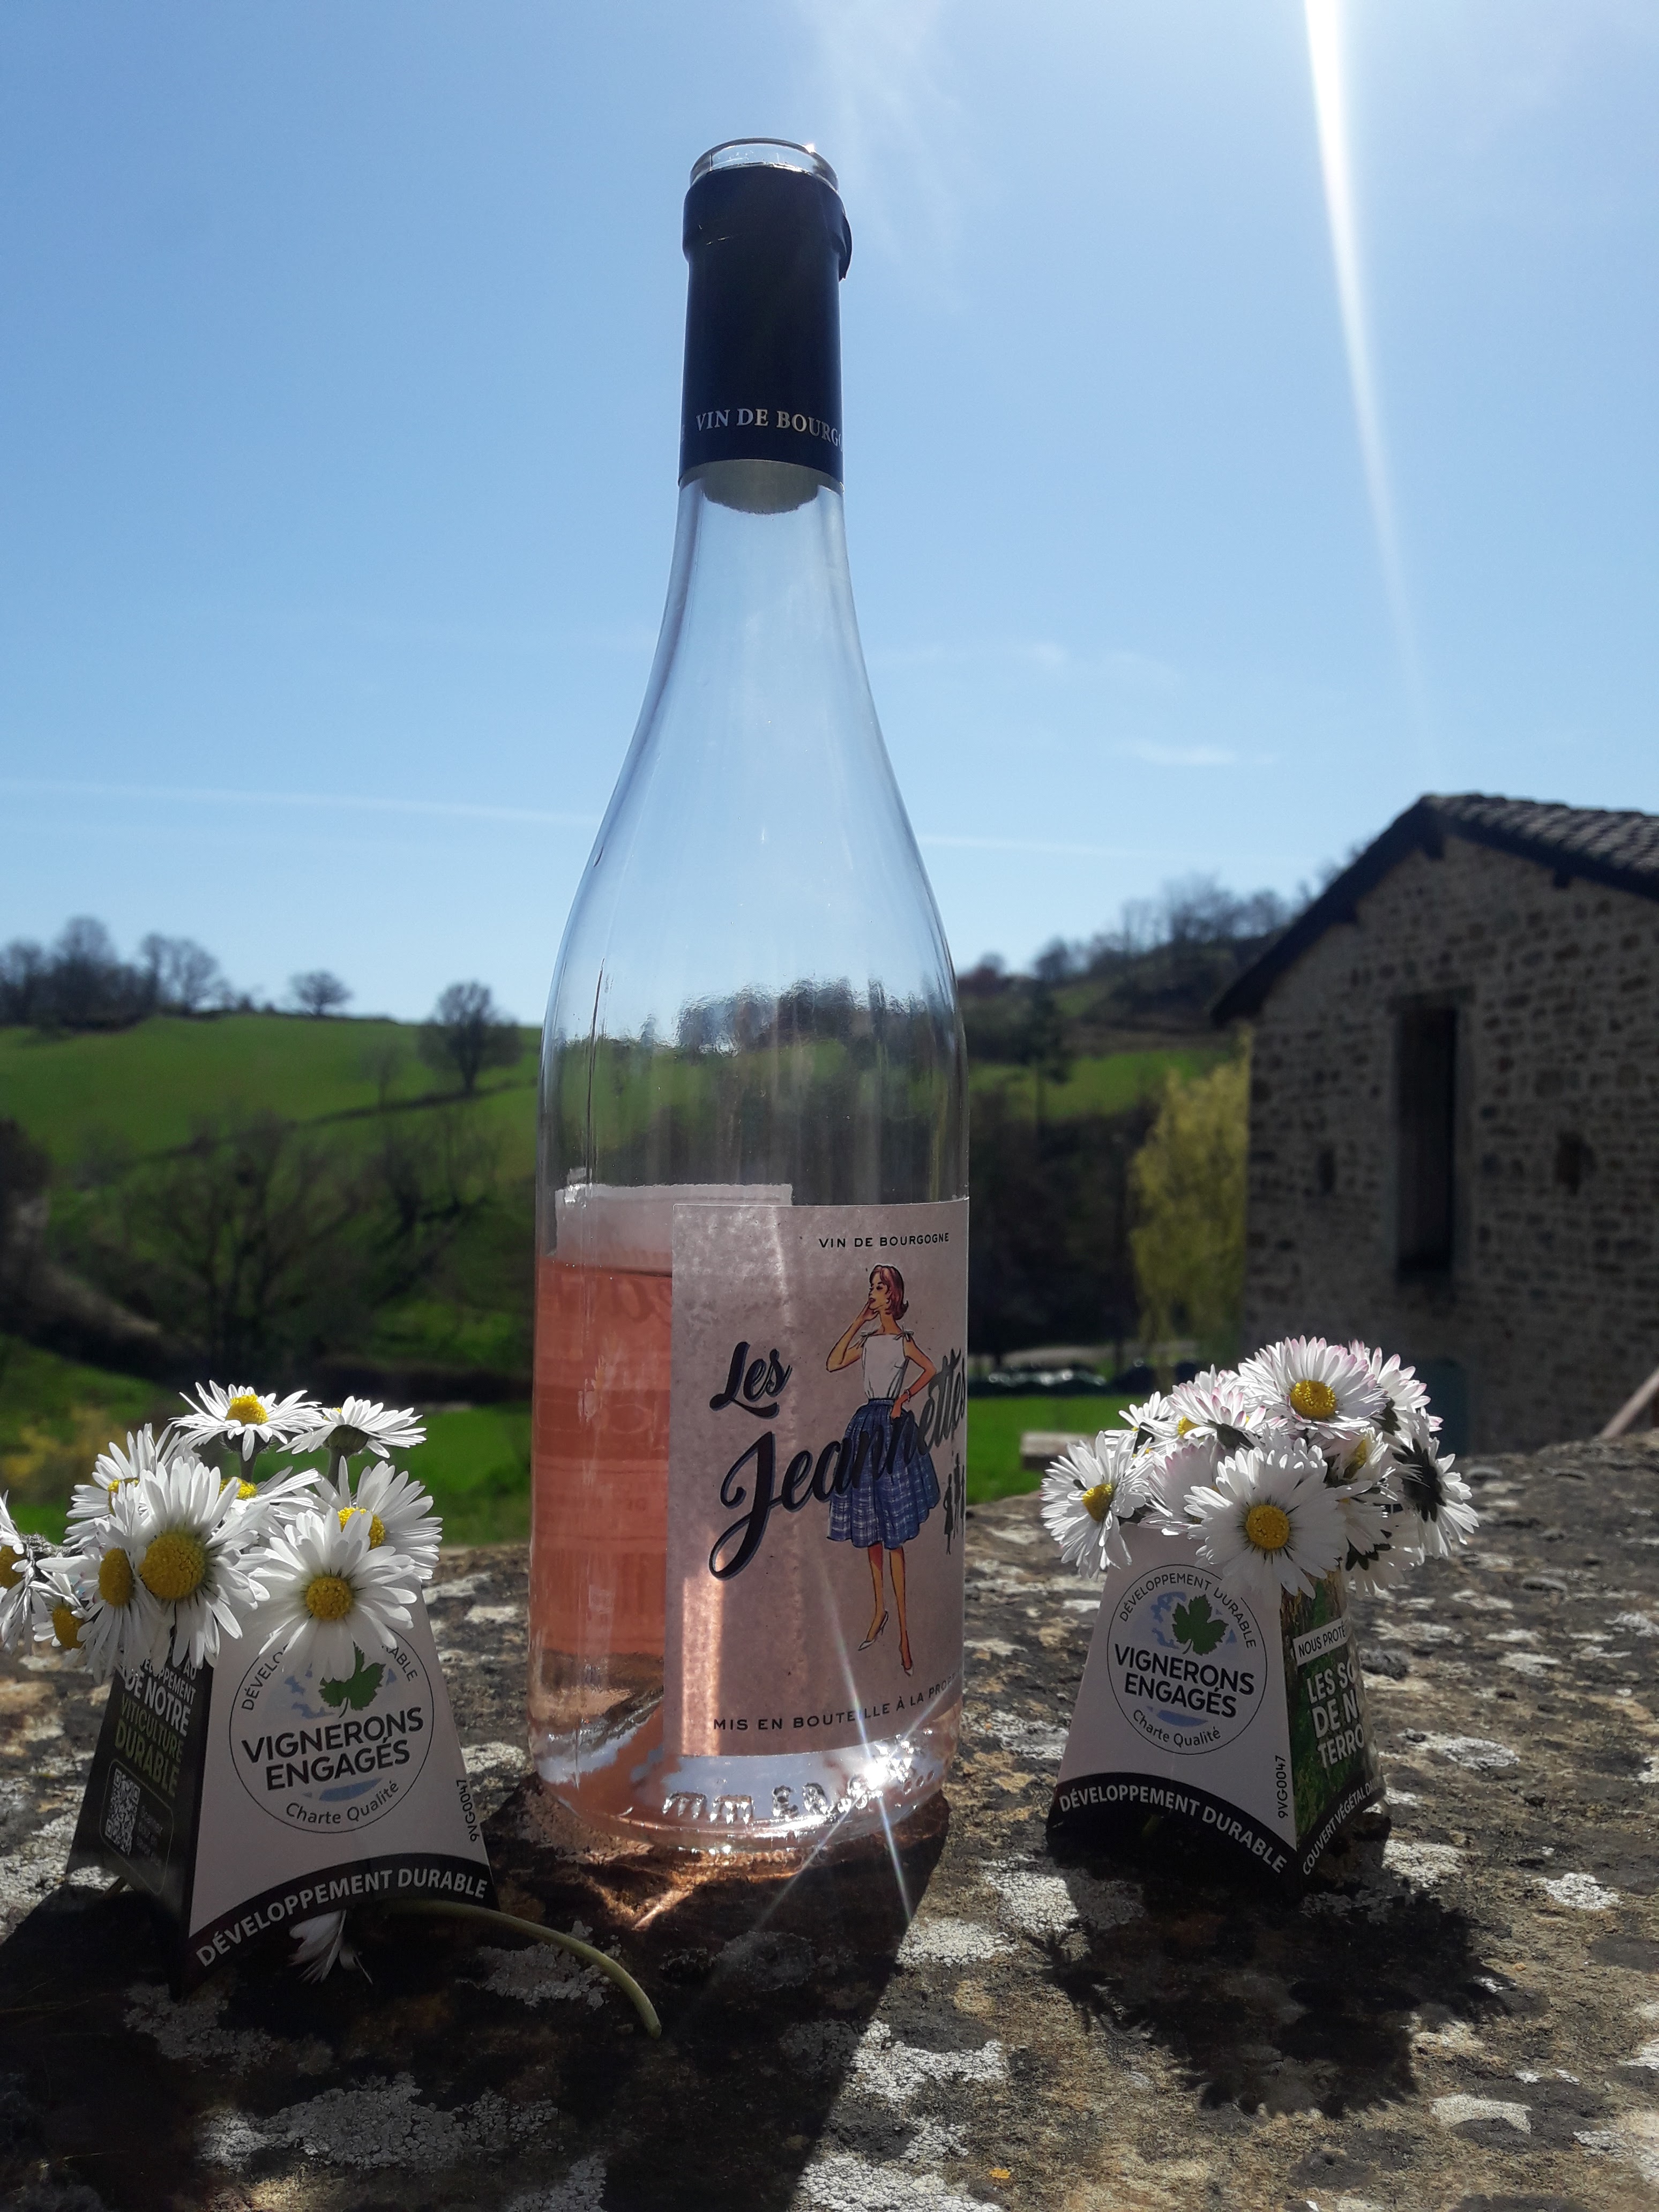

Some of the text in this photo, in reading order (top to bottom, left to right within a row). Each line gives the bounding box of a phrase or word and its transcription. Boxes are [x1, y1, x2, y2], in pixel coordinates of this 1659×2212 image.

[696, 409, 731, 432] VIN
[737, 408, 768, 427] DE
[819, 1232, 949, 1248] VIN DE BOURGOGNE
[709, 1341, 793, 1419] Les
[1119, 1572, 1213, 1623] DÉVELOPPEMENT
[1298, 1620, 1347, 1658] NOUS PROTÉ
[1115, 1643, 1255, 1696] VIGNERONS
[1124, 1671, 1237, 1718] ENGAGÉS
[1306, 1667, 1336, 1705] LES
[122, 1692, 185, 1763] VITICULTURE
[144, 1676, 191, 1738] NOTRE
[713, 1718, 749, 1730] MIS
[758, 1718, 782, 1730] EN
[793, 1702, 891, 1729] BOUTELLE
[896, 1695, 906, 1712] À
[910, 1692, 924, 1706] LA
[1133, 1709, 1221, 1748] Charte Qualité
[1311, 1696, 1340, 1738] DE
[114, 1718, 181, 1798] DURABLE
[241, 1706, 424, 1763] VIGNERONS
[267, 1736, 411, 1791] ENGAGÉS
[1275, 1755, 1289, 1819] 9VG0047
[286, 1780, 400, 1825] Charte Qualité
[455, 1778, 481, 1842] 9VG0047
[1059, 1784, 1288, 1874] DÉVELOPPEMENT DURABLE
[1302, 1786, 1366, 1876] COUVERT VÉGÉTAL
[195, 1867, 488, 1968] DÉVELOPPEMENT DURABLE
